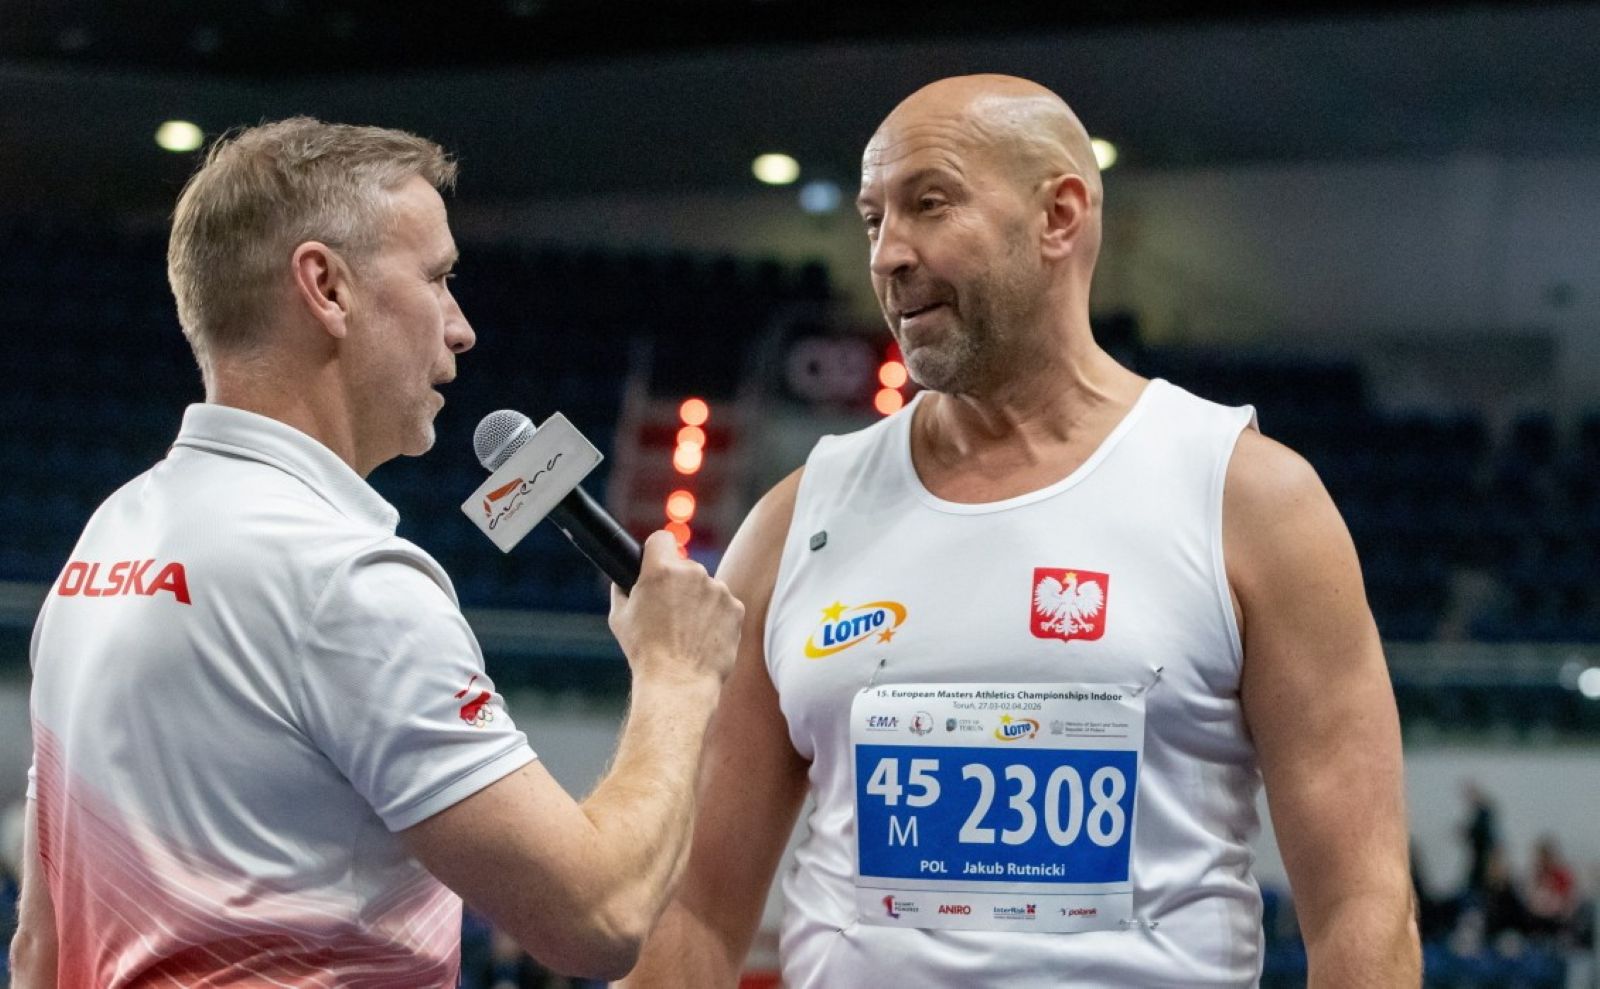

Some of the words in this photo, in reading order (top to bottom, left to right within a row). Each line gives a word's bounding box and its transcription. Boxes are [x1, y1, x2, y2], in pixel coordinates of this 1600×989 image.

[58, 559, 192, 605] OLSKA
[823, 609, 885, 646] LOTTO
[877, 690, 889, 698] 15.
[891, 690, 936, 699] European
[937, 690, 973, 698] Masters
[975, 691, 1015, 699] Athletics
[1017, 691, 1088, 701] Championships
[1091, 692, 1123, 701] Indoor
[979, 702, 1042, 711] 27.03-02.04.2026
[869, 716, 898, 727] EMA
[1004, 723, 1031, 736] LOTTO
[866, 757, 941, 807] 45
[958, 763, 1127, 847] 2308
[888, 815, 918, 847] M
[920, 860, 948, 873] POL
[963, 861, 1004, 875] Jakub
[1007, 862, 1066, 876] Rutnicki
[938, 905, 971, 915] ANIRO
